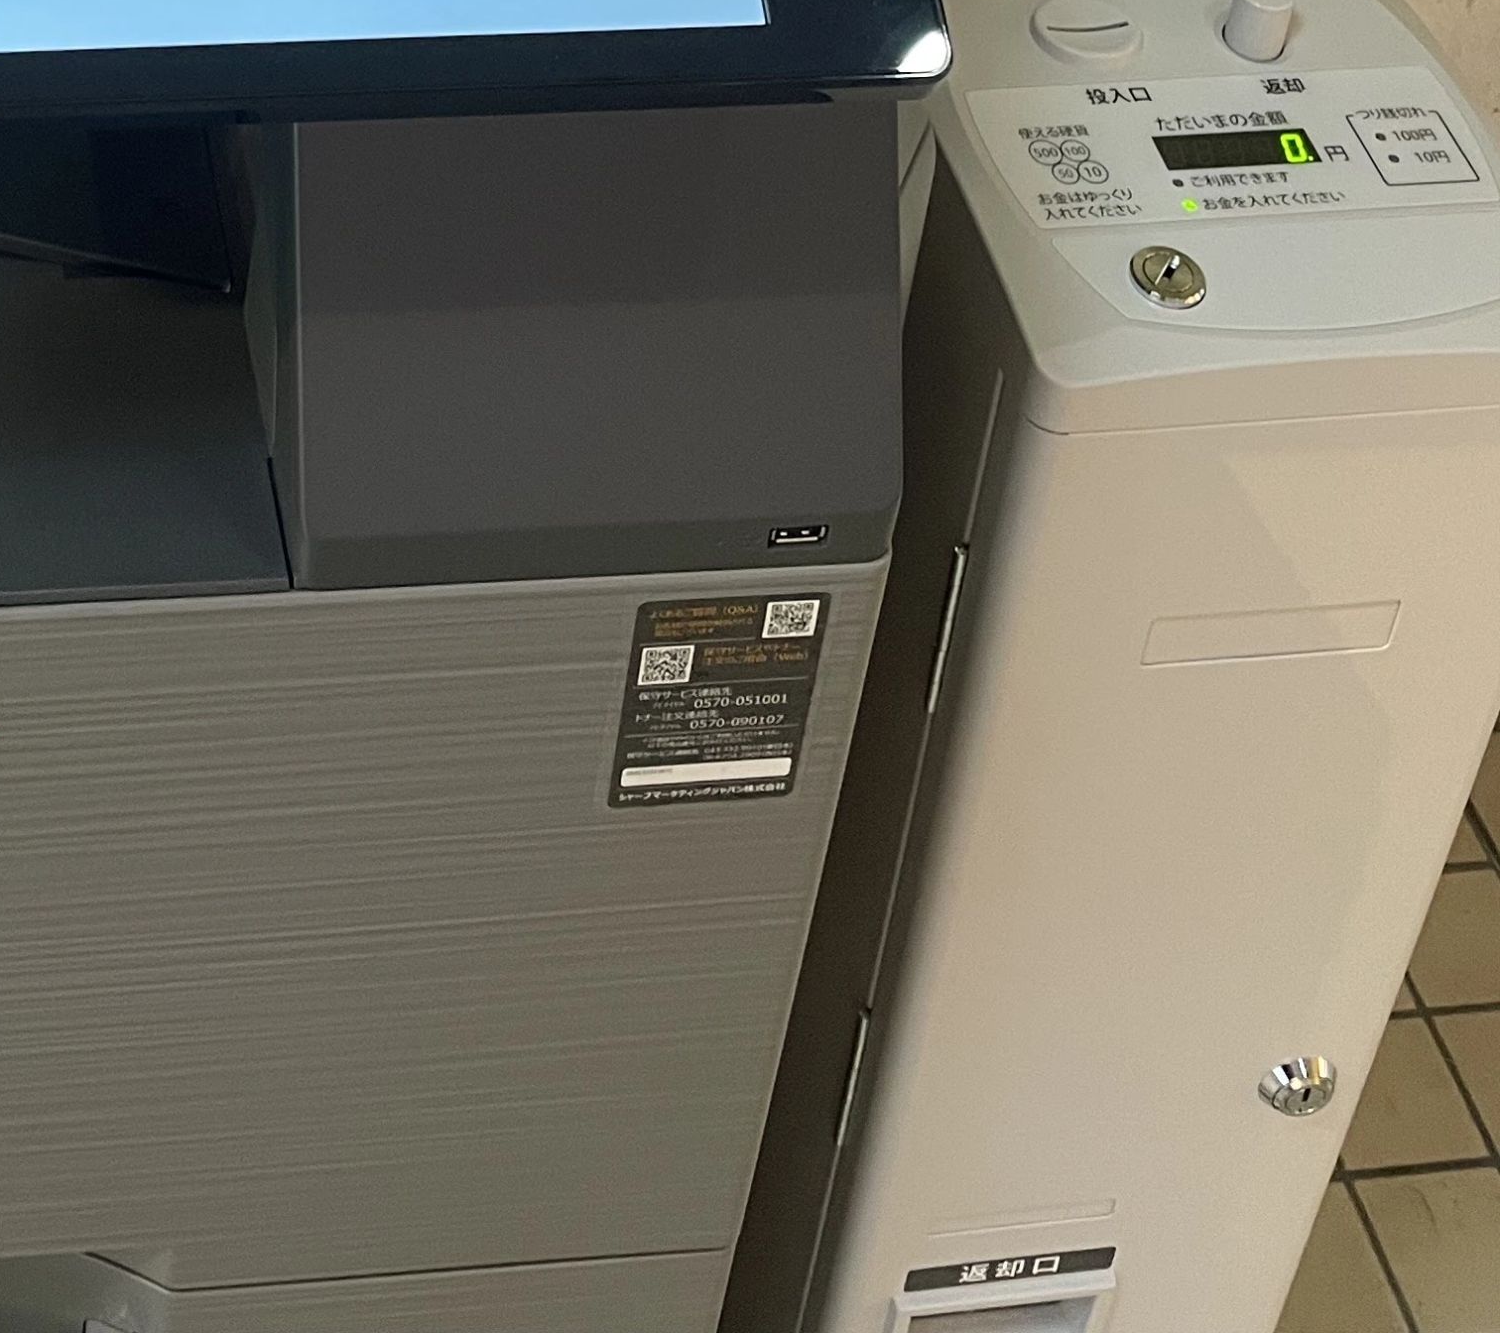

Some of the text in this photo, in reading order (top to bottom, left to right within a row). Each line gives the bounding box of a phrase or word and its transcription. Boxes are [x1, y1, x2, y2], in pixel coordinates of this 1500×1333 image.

[1260, 78, 1306, 95] 返却
[1086, 87, 1152, 105] 投入口
[1156, 110, 1289, 131] ただいまの金額
[1392, 128, 1438, 141] 100円
[1033, 147, 1059, 159] 500
[1063, 144, 1087, 156] 100
[1324, 145, 1350, 162] 円
[1414, 150, 1451, 163] 10円
[1058, 167, 1074, 179] 50
[1083, 166, 1102, 178] 10
[1190, 171, 1288, 188] ご利用できます
[1037, 188, 1132, 206] お金はゆっくり
[1202, 191, 1346, 210] お金を入れてください
[1045, 205, 1143, 221] 入れてください
[959, 1255, 1060, 1283] 返却口
